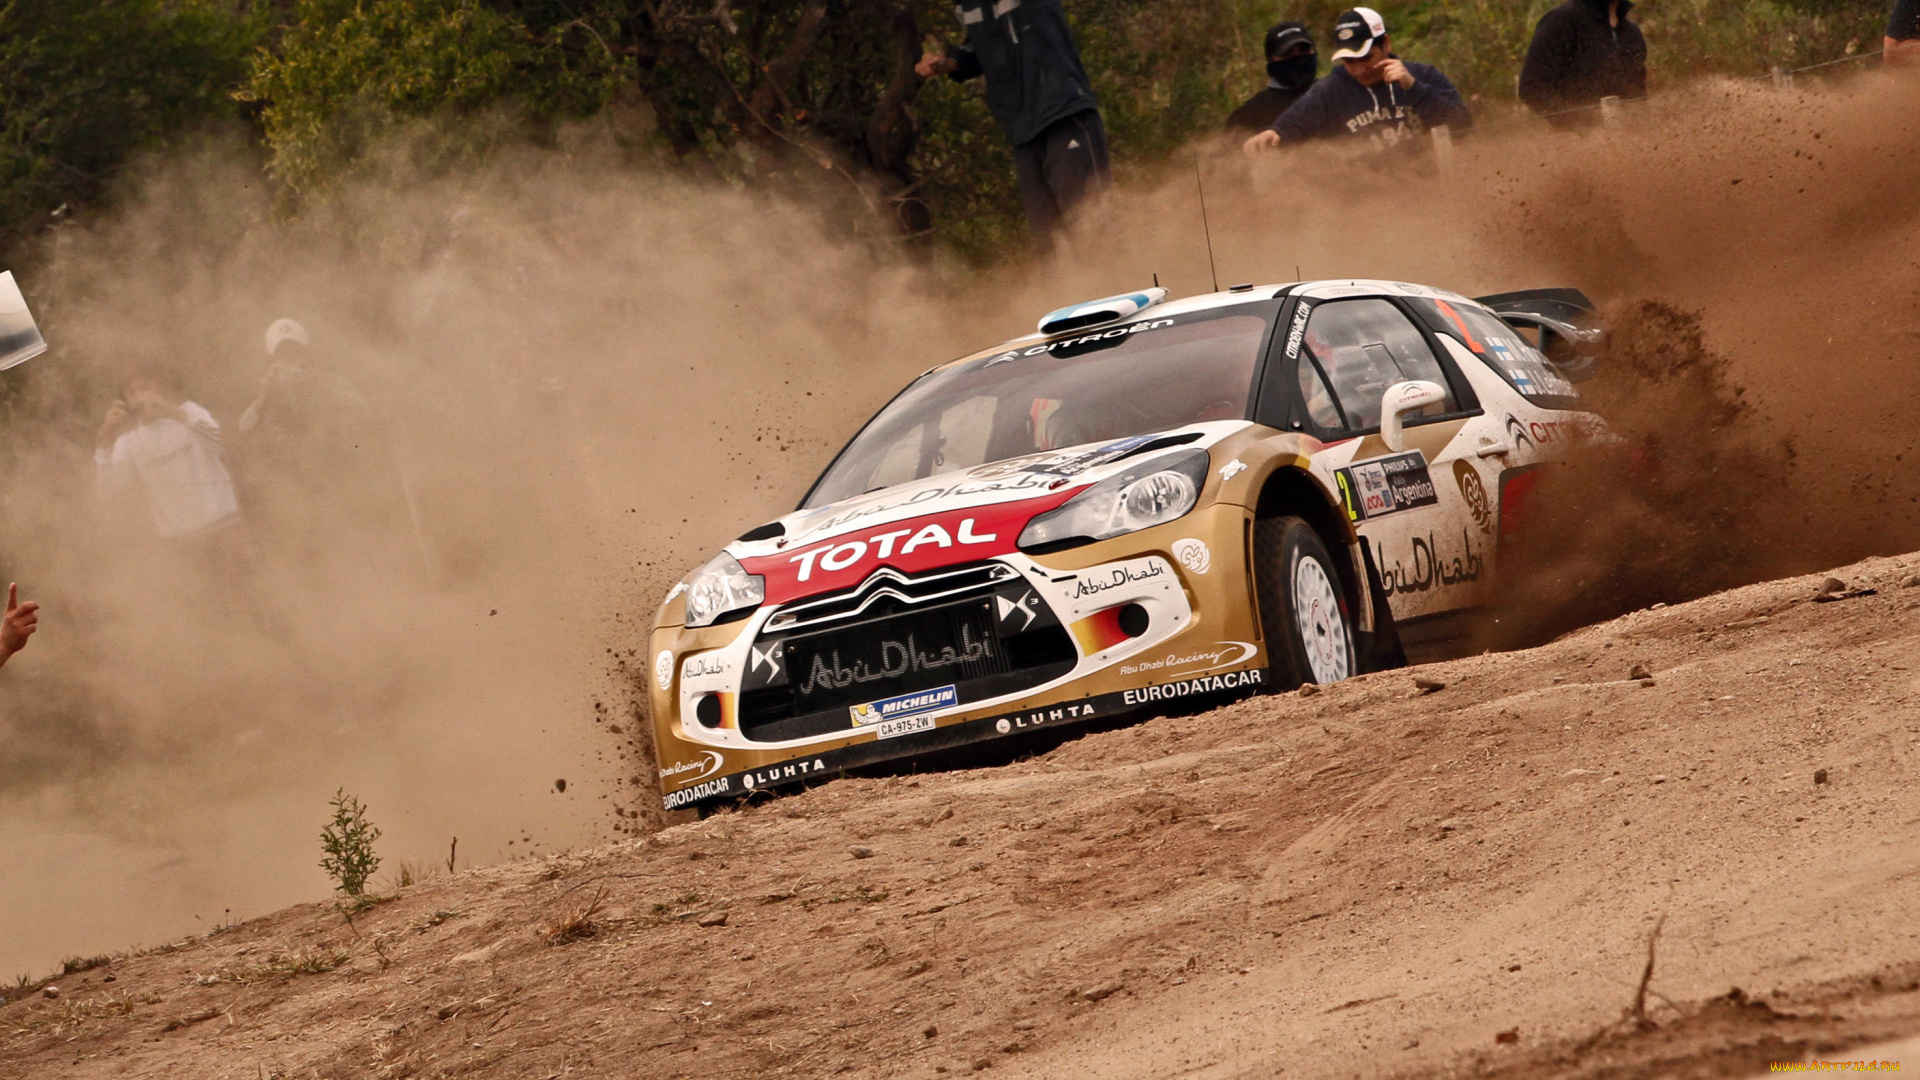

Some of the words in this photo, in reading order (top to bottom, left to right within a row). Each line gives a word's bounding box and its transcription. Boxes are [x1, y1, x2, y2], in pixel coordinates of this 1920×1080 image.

[1336, 471, 1357, 521] 2
[1391, 480, 1434, 506] Argentina
[789, 518, 997, 582] TOTAL
[1073, 578, 1113, 599] Abu
[1112, 560, 1165, 587] Dhabi
[881, 623, 993, 678] Dhabi
[1120, 665, 1138, 676] Abu
[1139, 659, 1165, 672] Dhabi
[1165, 646, 1238, 668] Racing
[1123, 669, 1262, 706] EURODATACAR
[882, 690, 954, 714] MICHELIN
[1015, 703, 1095, 728] LUHTA
[881, 716, 929, 736] CA-975-ZW
[674, 756, 713, 774] Racing
[756, 758, 825, 784] LUHTA
